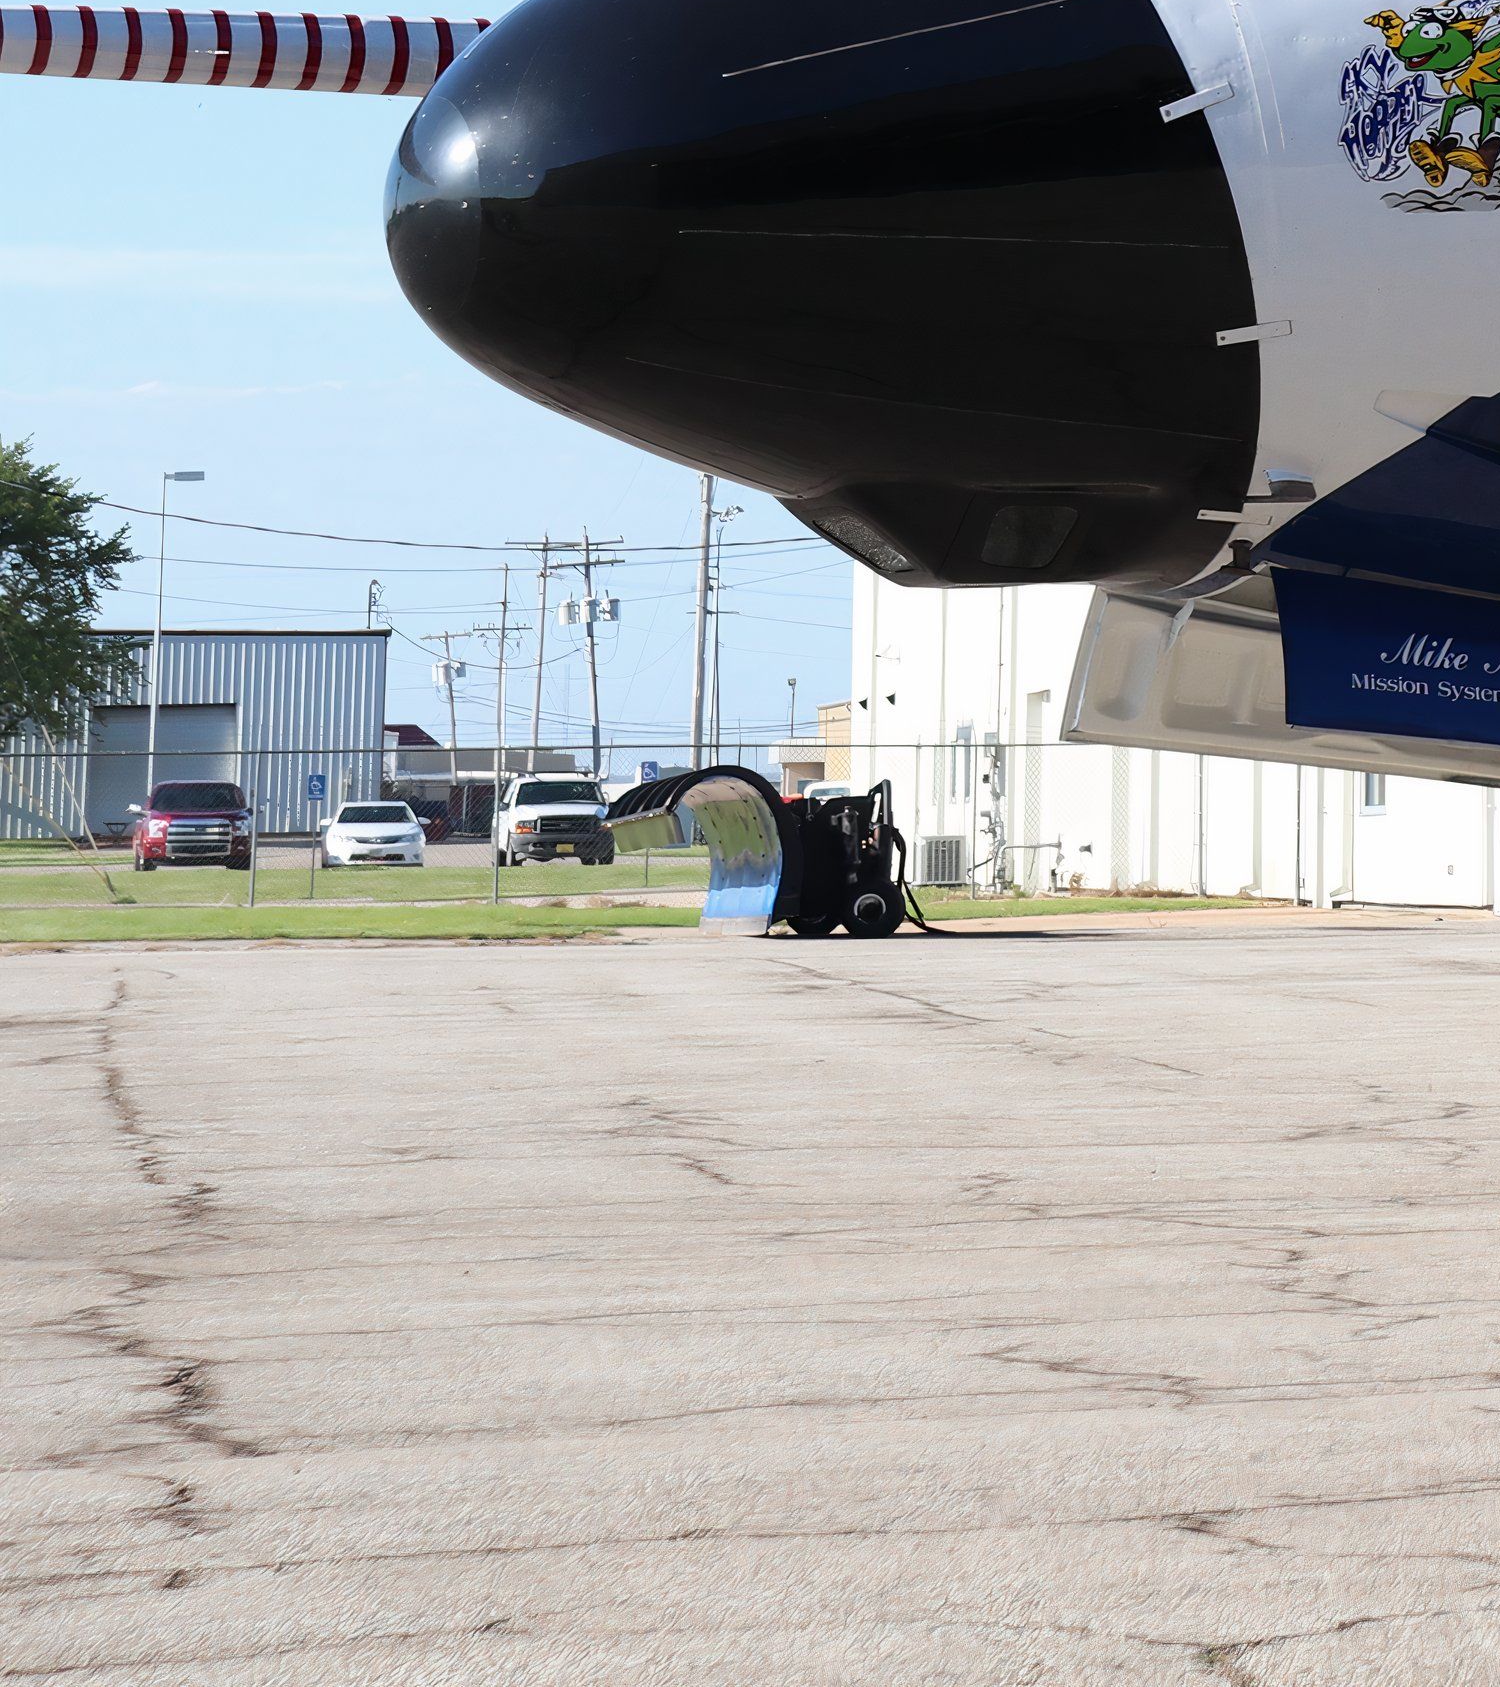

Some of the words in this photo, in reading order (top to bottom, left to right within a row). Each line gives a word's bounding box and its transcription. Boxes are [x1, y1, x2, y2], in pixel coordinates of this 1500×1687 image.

[1339, 44, 1396, 112] SKY
[1380, 633, 1469, 672] Mike
[1350, 673, 1430, 696] Mission
